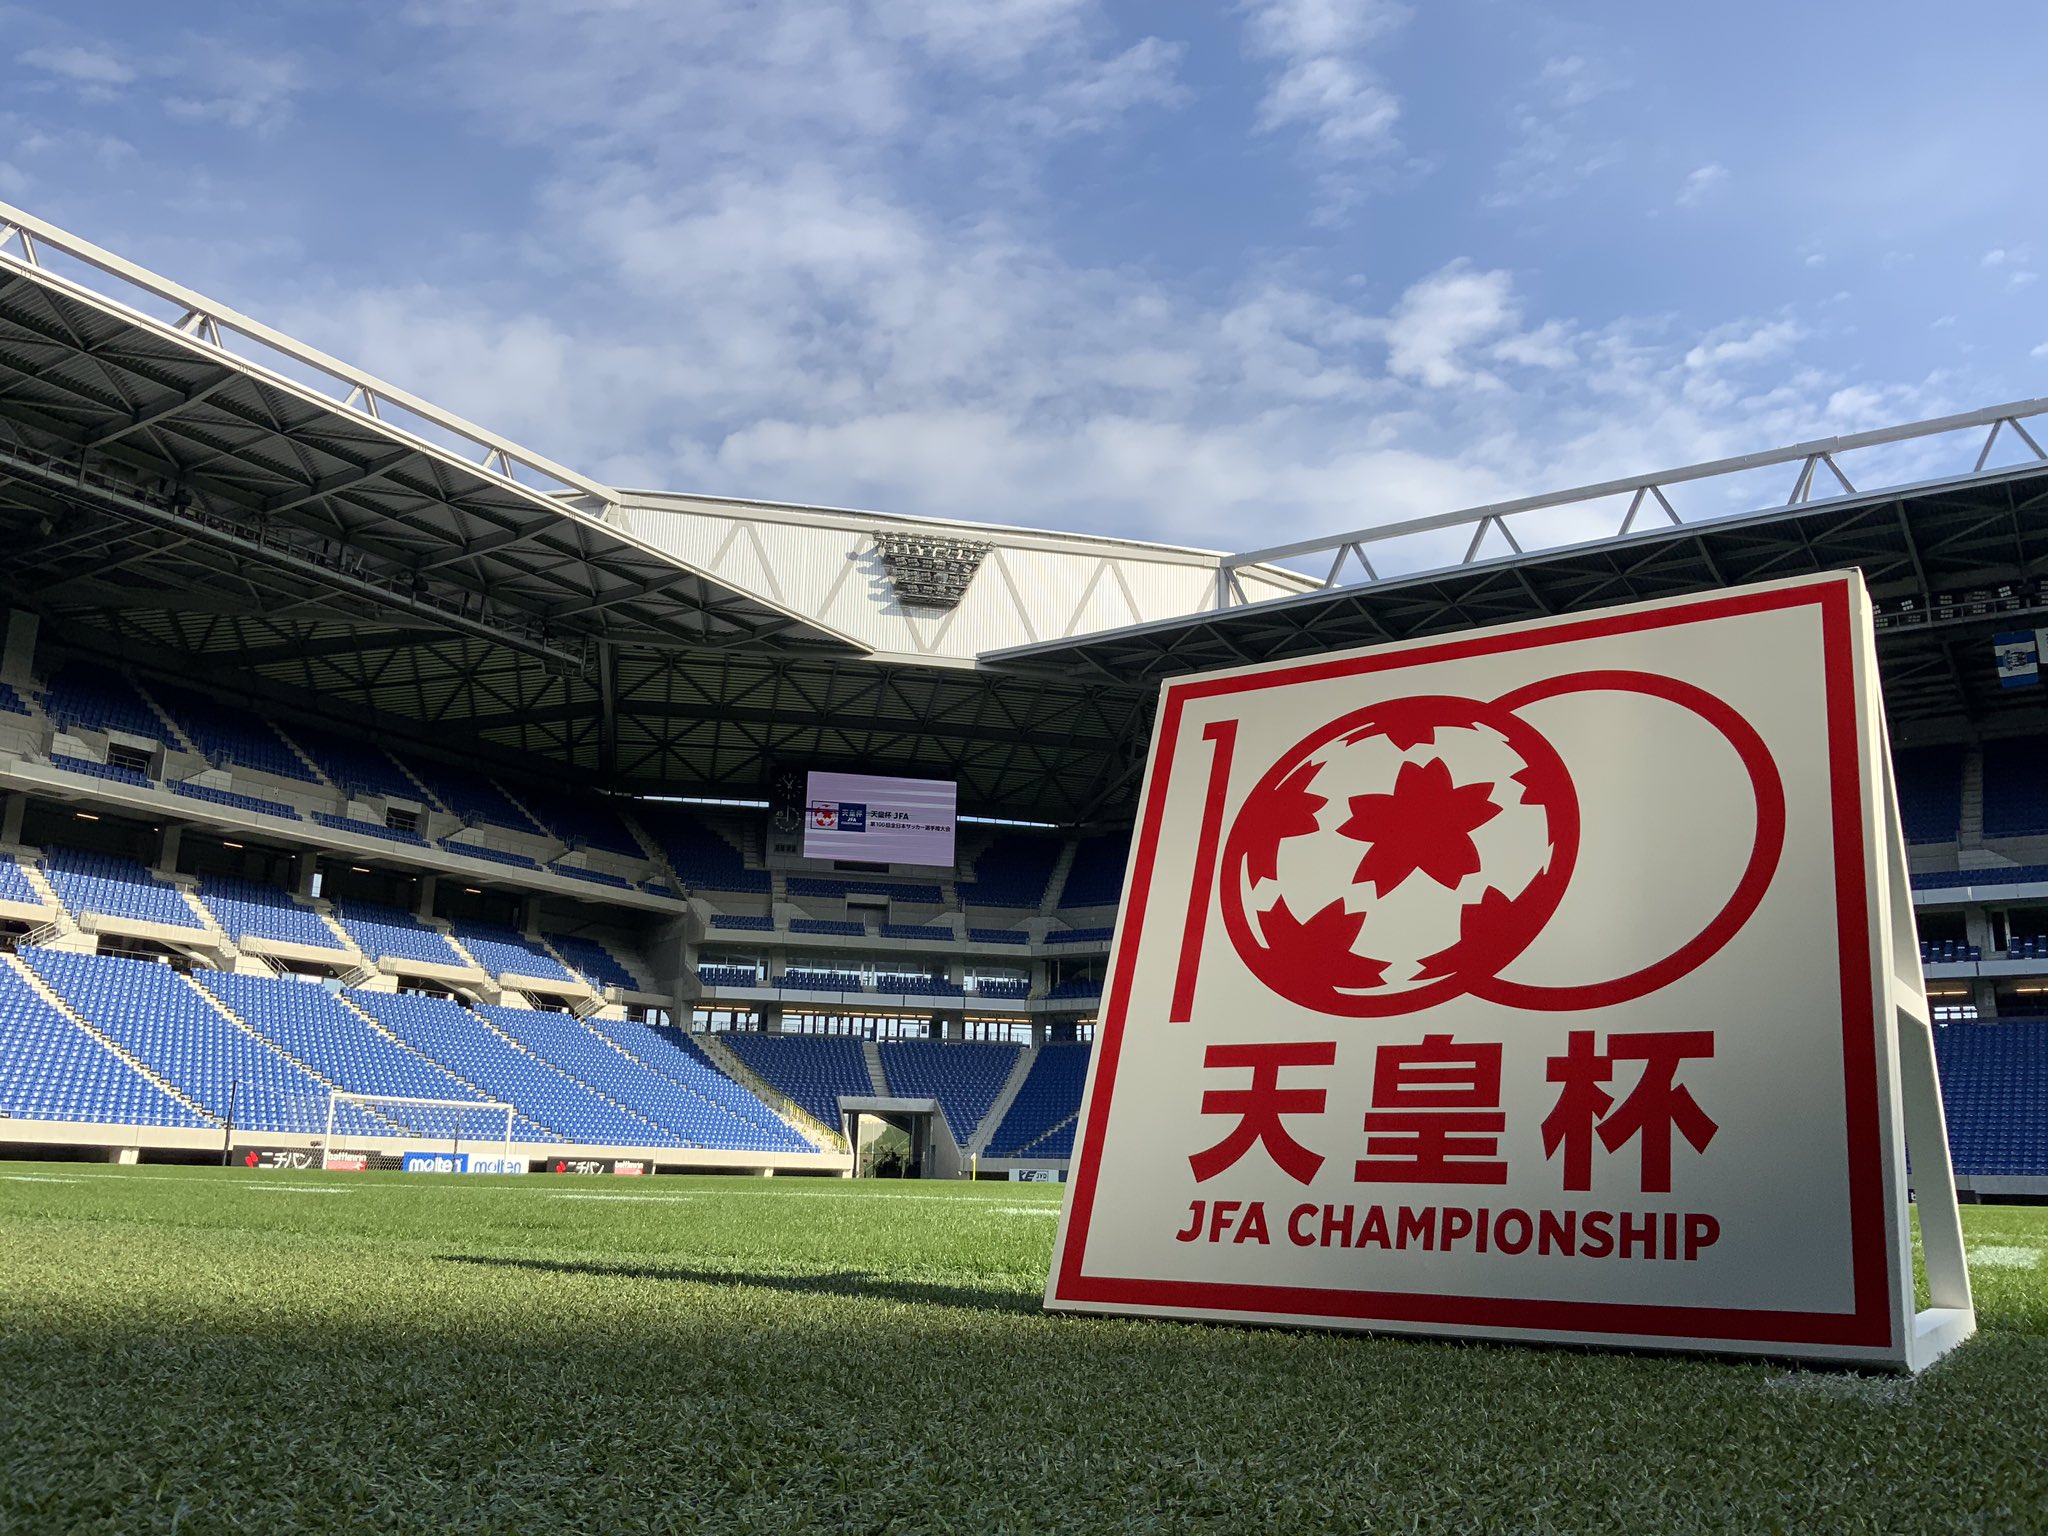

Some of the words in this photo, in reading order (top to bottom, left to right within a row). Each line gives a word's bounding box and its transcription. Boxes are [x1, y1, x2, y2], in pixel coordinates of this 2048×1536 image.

[870, 810, 892, 820] 天皇杯
[893, 812, 910, 821] JFA
[1188, 1031, 1718, 1193] 天皇杯
[259, 1152, 313, 1169] ニチバン
[408, 1156, 463, 1172] molten
[474, 1158, 522, 1173] molten
[566, 1161, 605, 1174] ニチバン
[1176, 1200, 1270, 1245] JFA
[1288, 1203, 1721, 1261] CHAMPIONSHIP
